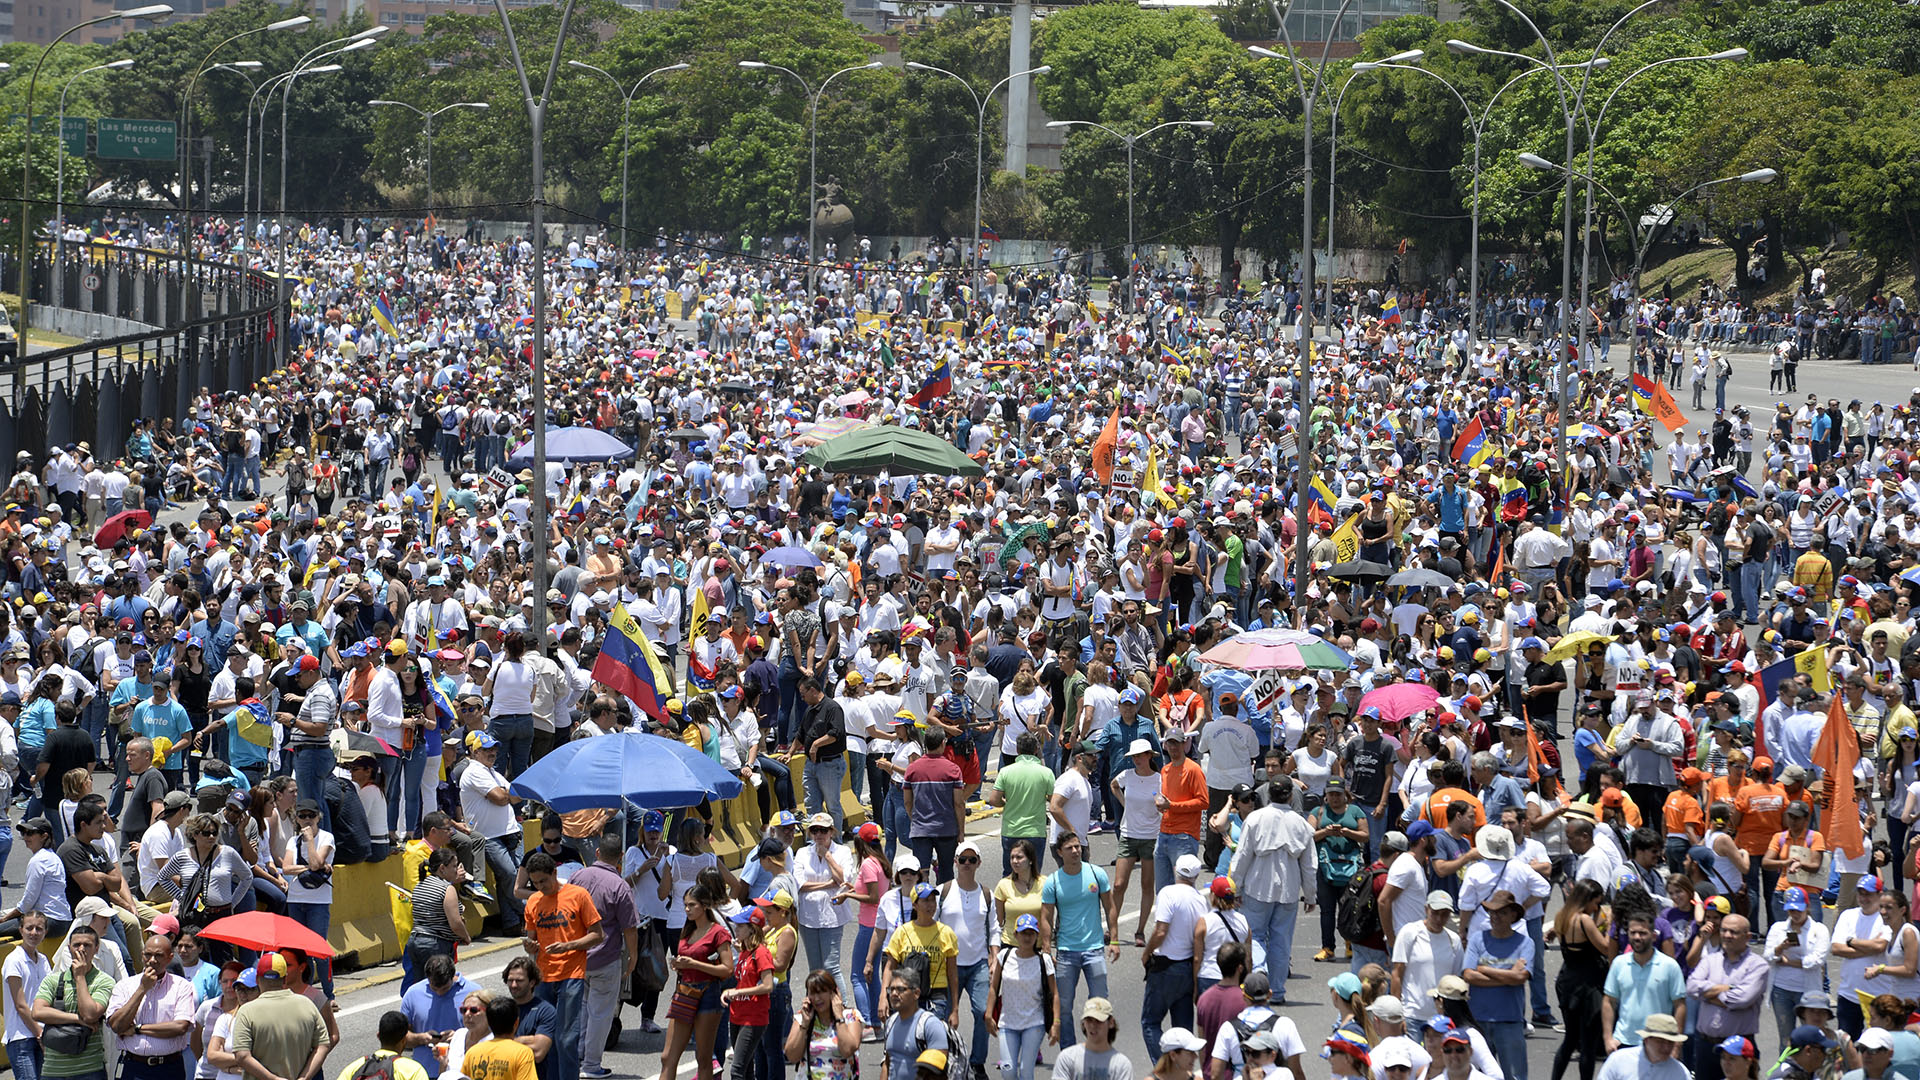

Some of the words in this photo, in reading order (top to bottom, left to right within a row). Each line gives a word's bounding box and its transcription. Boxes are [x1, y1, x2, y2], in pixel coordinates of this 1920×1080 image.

[100, 122, 118, 131] Las
[123, 123, 173, 133] Mercedes
[116, 134, 158, 143] Chacao
[1113, 473, 1132, 483] NO+
[1819, 493, 1837, 512] NO+
[984, 551, 996, 565] 16
